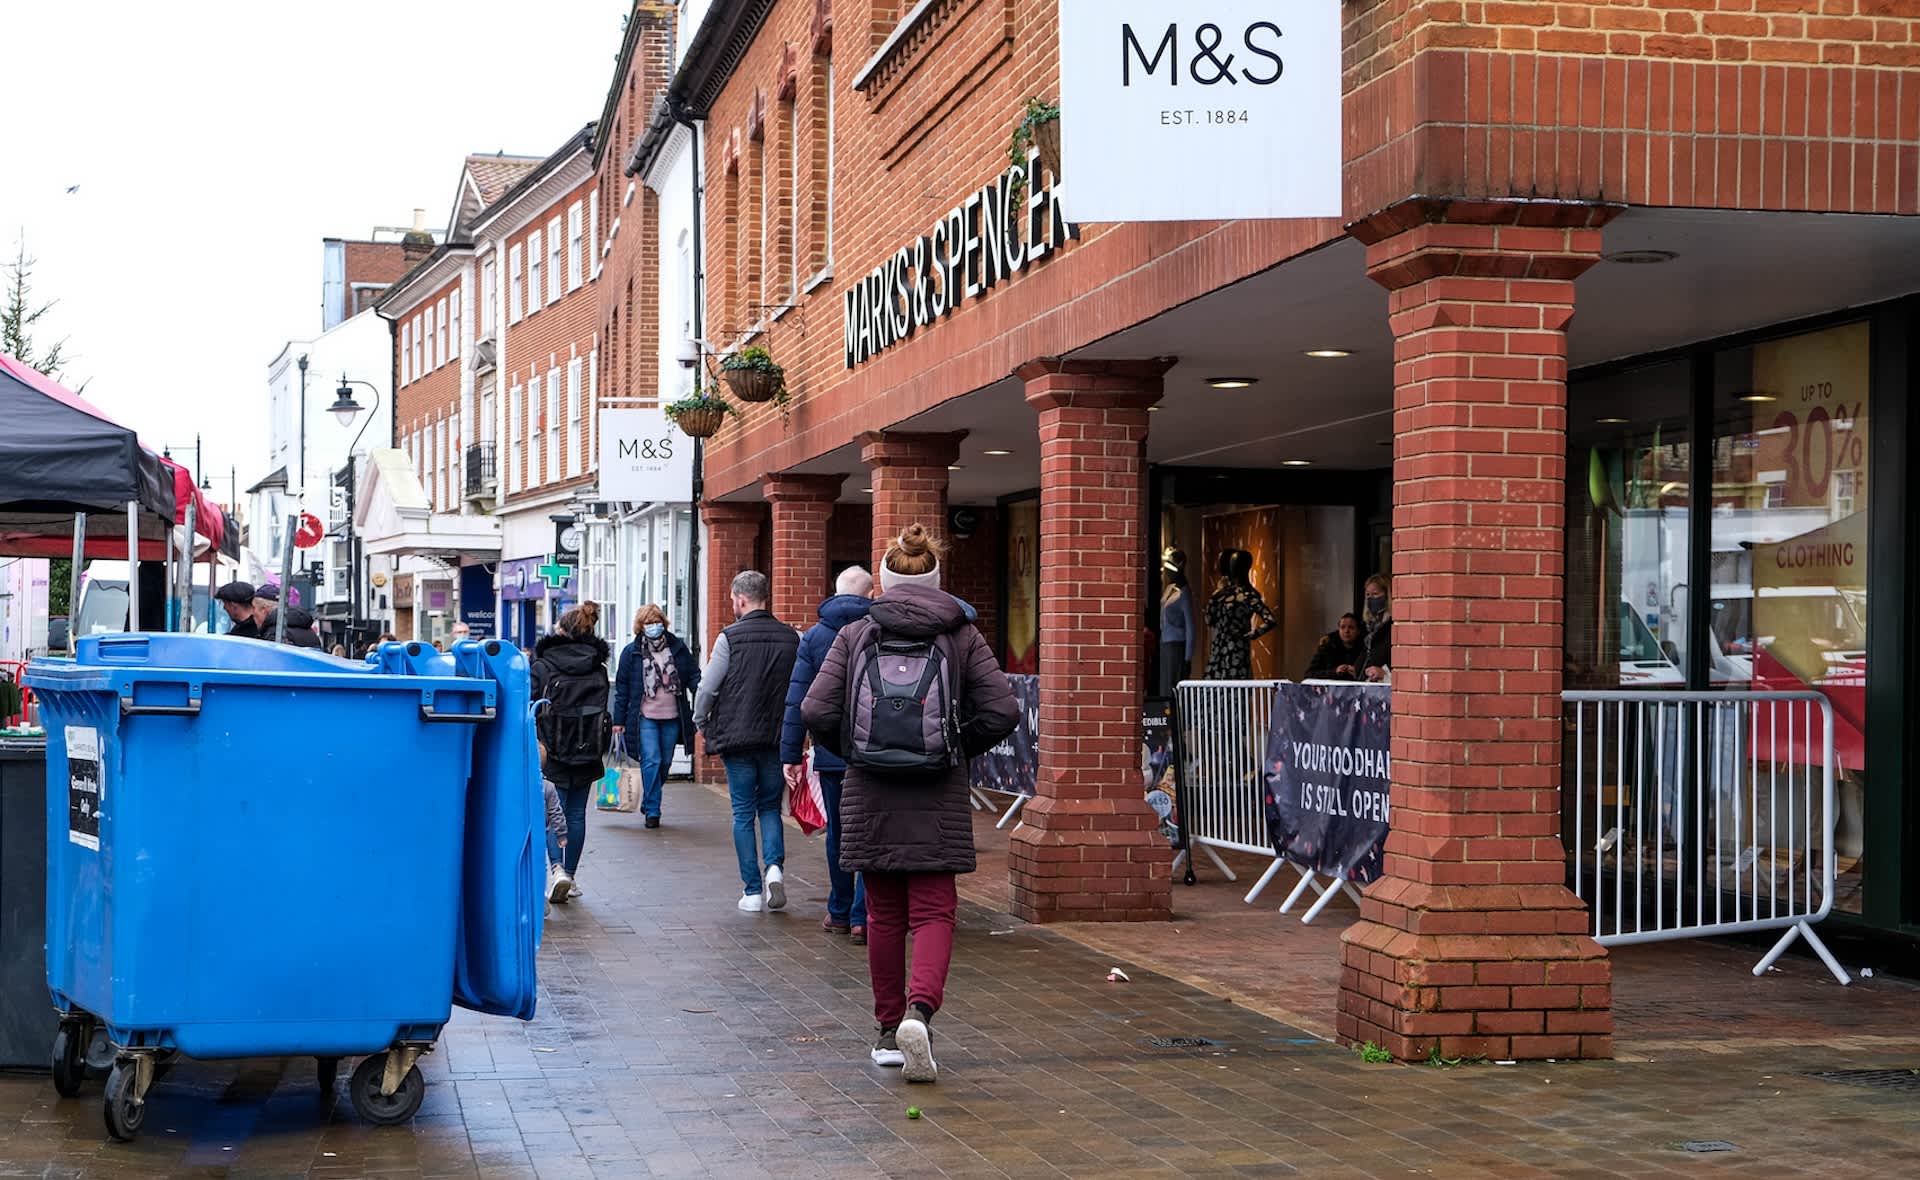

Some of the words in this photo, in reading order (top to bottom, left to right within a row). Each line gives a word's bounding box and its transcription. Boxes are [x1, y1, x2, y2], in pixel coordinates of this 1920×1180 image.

[1122, 21, 1283, 86] M&S
[1160, 110, 1200, 125] EST.
[1207, 110, 1249, 124] 1884
[844, 247, 912, 369] MARKS
[913, 235, 931, 326] &
[1801, 385, 1815, 402] UP
[1817, 382, 1832, 399] TO
[619, 438, 673, 459] M&S
[1776, 543, 1854, 569] CLOTHING
[1143, 717, 1168, 726] EDIBLE
[1301, 782, 1313, 810] IS
[1315, 785, 1348, 817] STILL
[1352, 789, 1390, 823] OPEN
